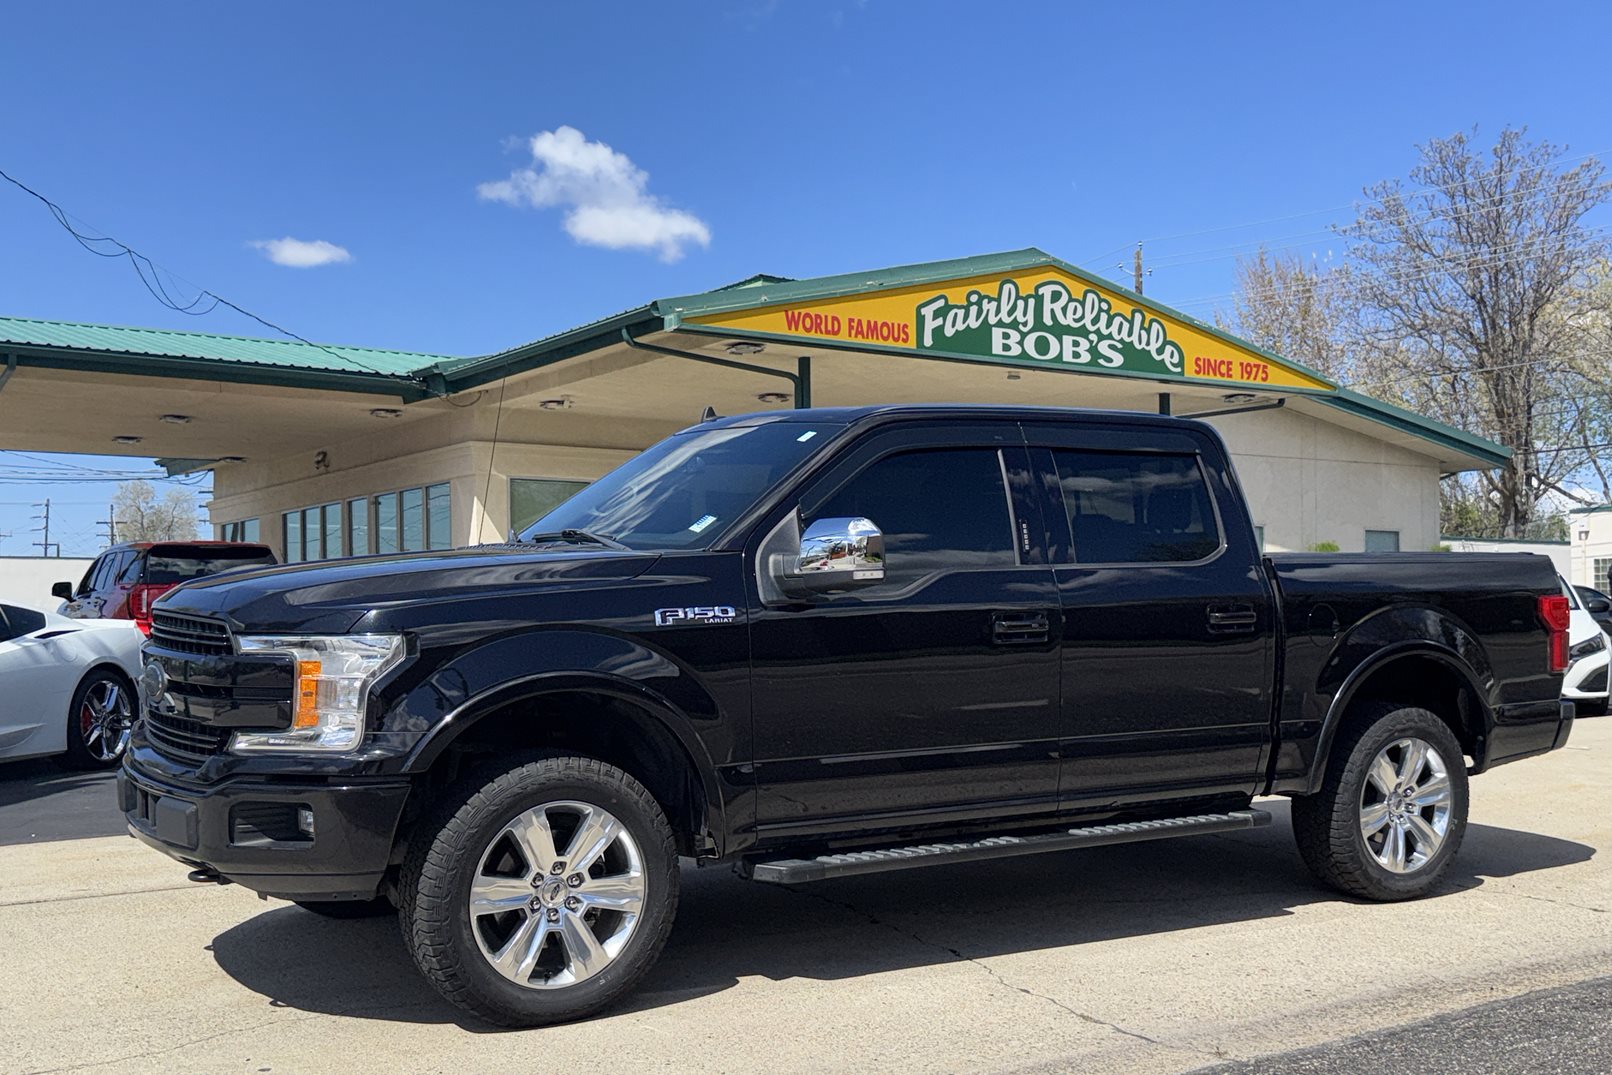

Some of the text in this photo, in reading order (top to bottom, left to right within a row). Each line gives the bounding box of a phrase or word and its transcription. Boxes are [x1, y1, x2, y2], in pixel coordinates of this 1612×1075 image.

[784, 309, 909, 343] WORLD FAMOUS
[920, 283, 1182, 373] Fairly Reliable
[991, 327, 1125, 368] BOB'S
[1194, 357, 1269, 382] SINCE 1975
